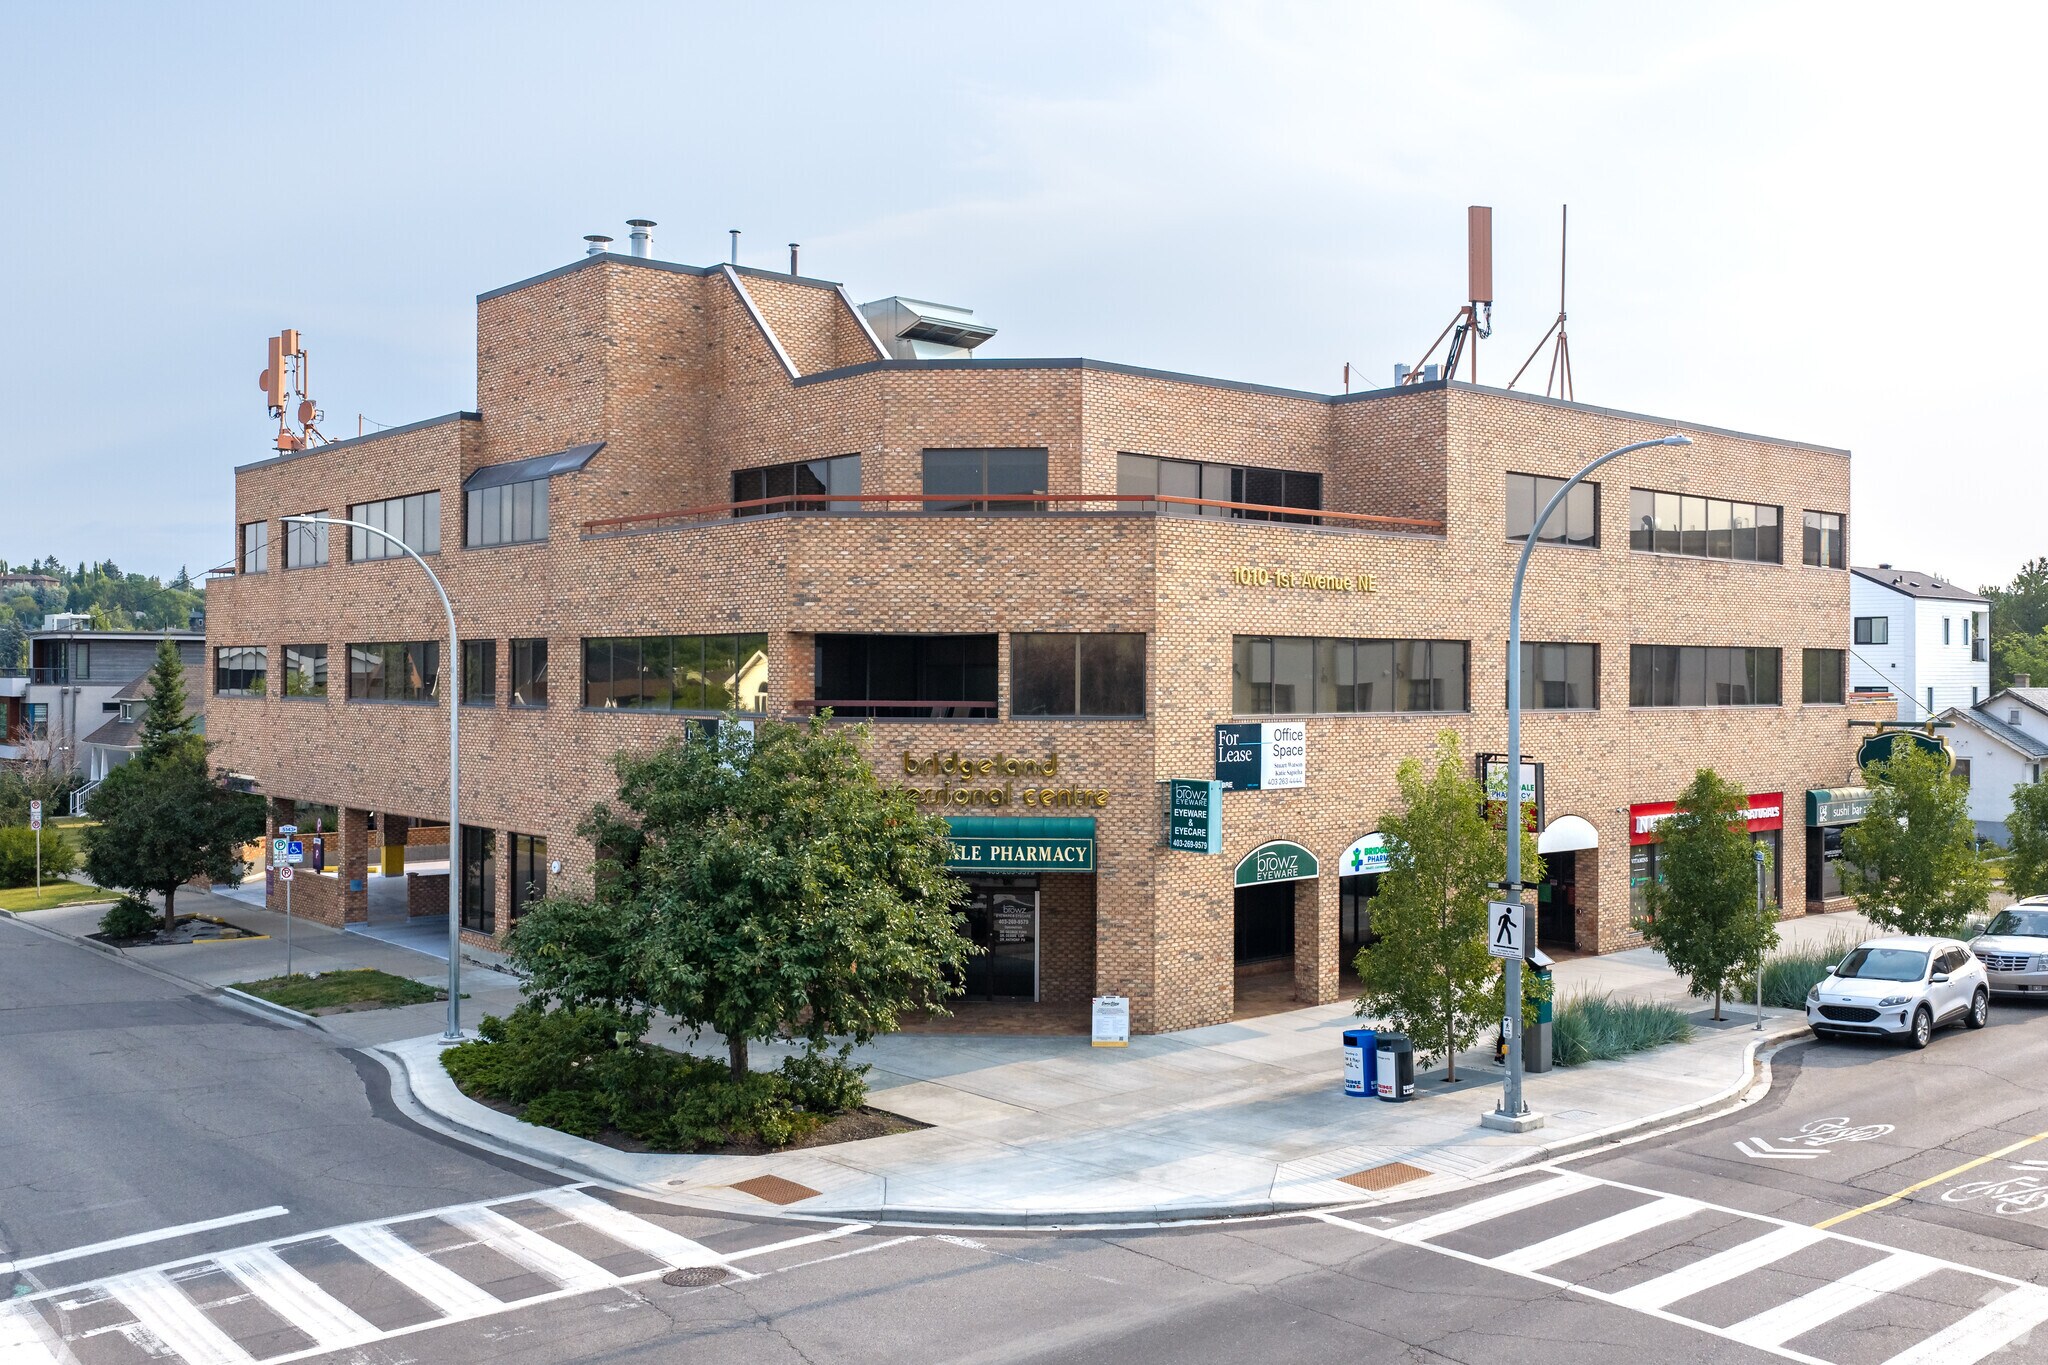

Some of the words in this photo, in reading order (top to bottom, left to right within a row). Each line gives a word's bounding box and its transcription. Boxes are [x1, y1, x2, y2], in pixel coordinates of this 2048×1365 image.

[1233, 566, 1296, 588] 1010-1st
[1301, 571, 1352, 591] Avenue
[1357, 574, 1378, 592] NE
[1218, 730, 1239, 746] For
[1274, 728, 1303, 742] Office
[1218, 747, 1253, 763] Lease
[1273, 744, 1303, 759] Space
[904, 751, 1057, 781] bridgeland
[1268, 778, 1278, 786] 403
[1279, 777, 1289, 785] 263
[1023, 783, 1110, 807] centre
[1175, 783, 1208, 800] browz
[1174, 809, 1207, 818] EYEWARE
[1833, 803, 1850, 818] sushi
[1852, 803, 1863, 815] bar
[1174, 828, 1207, 837] EYECARE
[990, 846, 1087, 862] PHARMACY
[1253, 850, 1299, 872] browz
[1256, 867, 1299, 881] EYEWARE
[1003, 905, 1026, 913] browz
